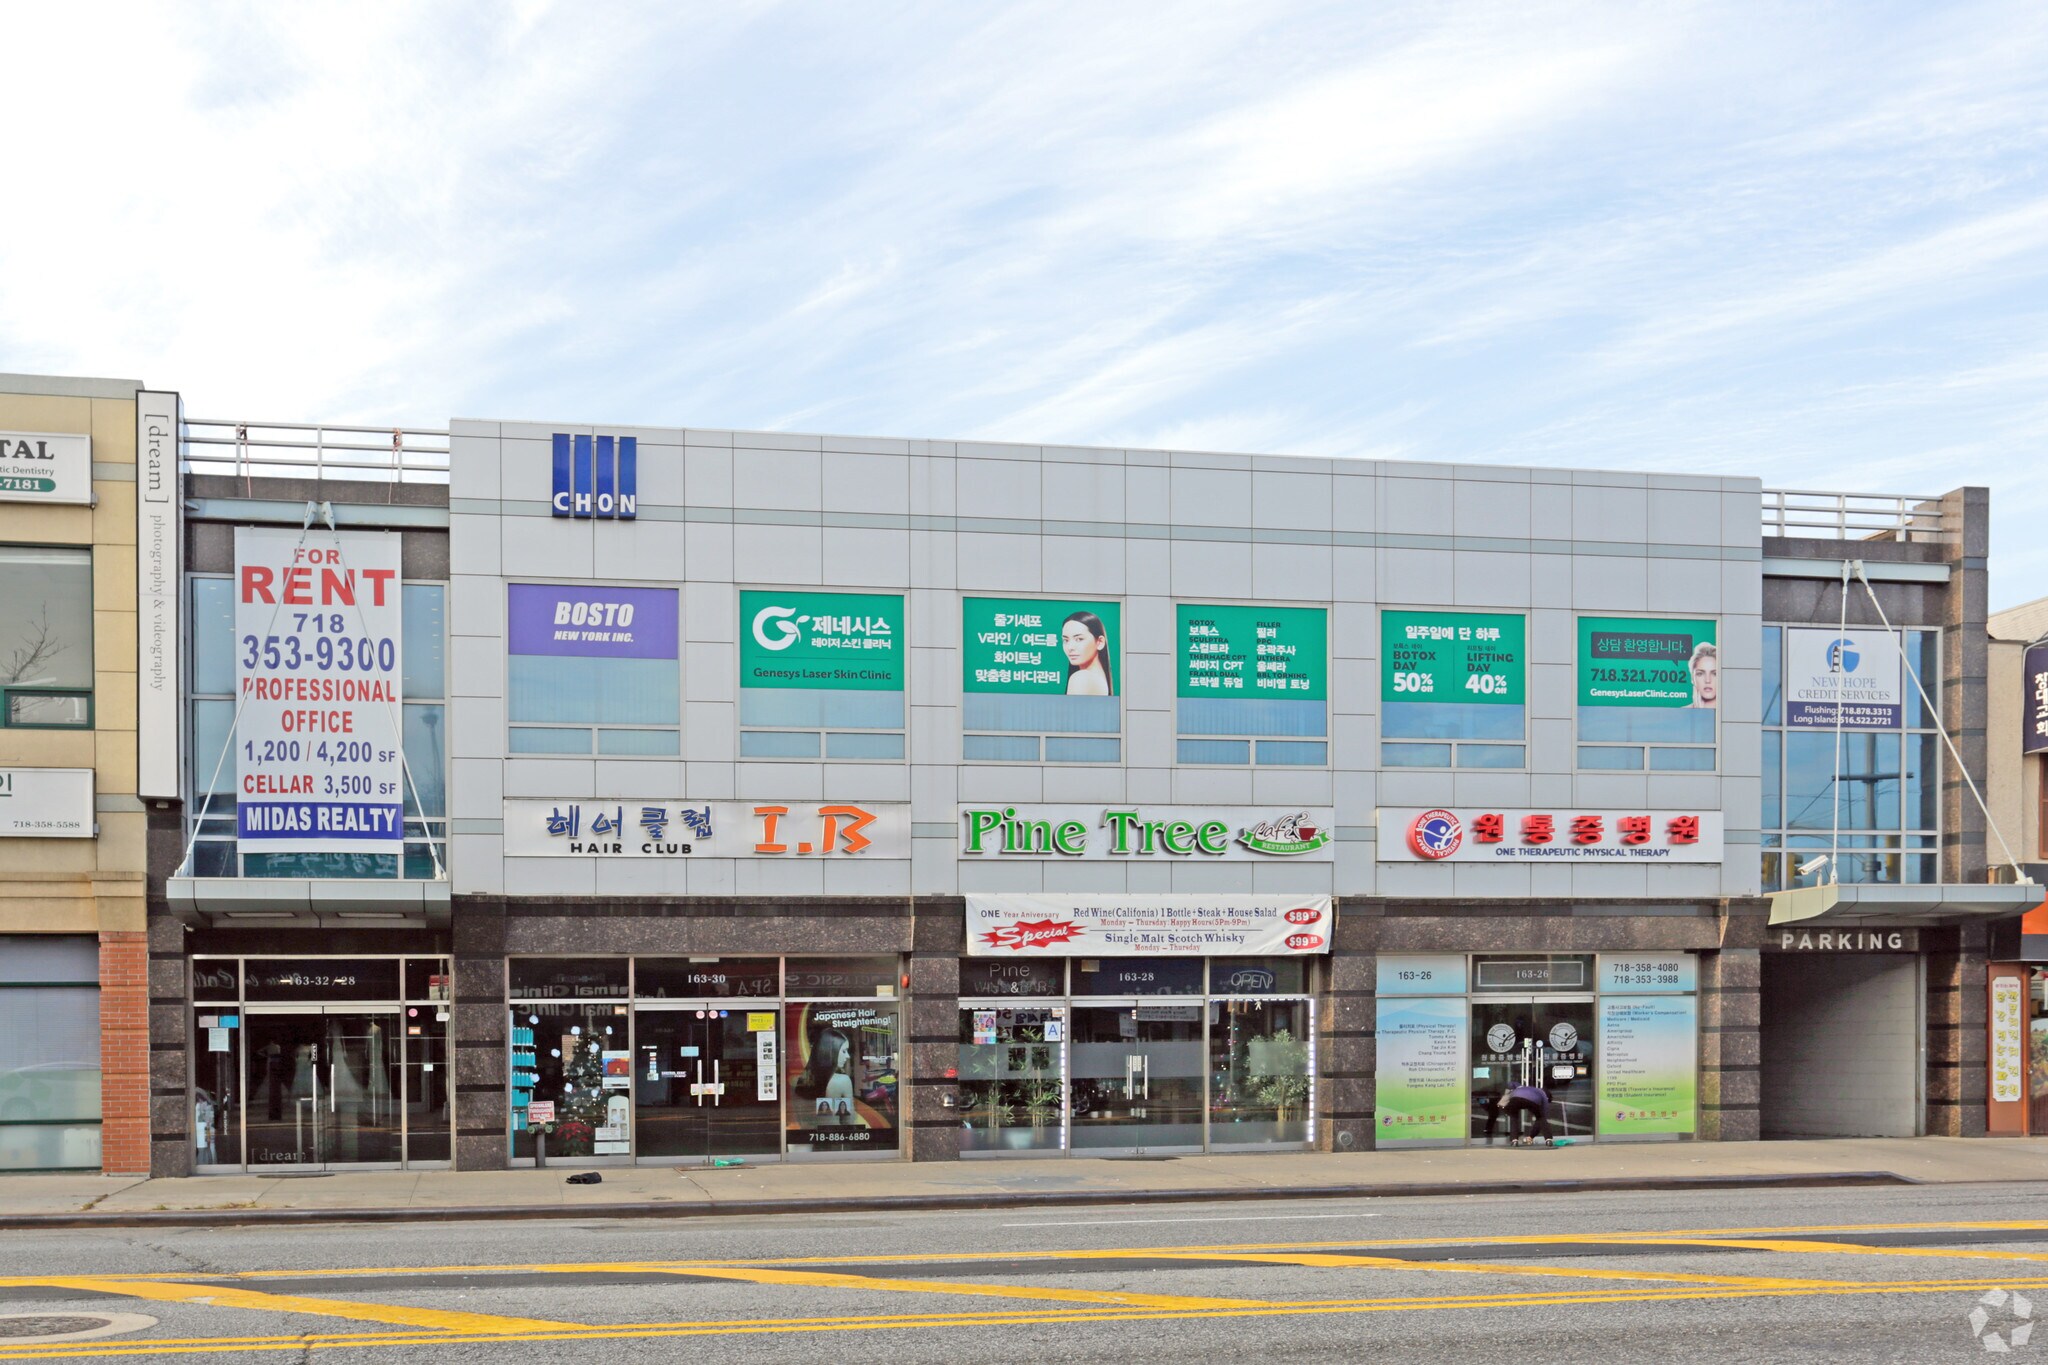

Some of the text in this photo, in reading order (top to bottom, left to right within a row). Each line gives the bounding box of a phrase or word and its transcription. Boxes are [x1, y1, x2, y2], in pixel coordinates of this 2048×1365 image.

[12, 466, 54, 477] Dentistry
[553, 492, 636, 513] CHON
[294, 549, 340, 565] FOR
[241, 566, 395, 607] RENT
[149, 514, 167, 691] photography & videography
[554, 602, 634, 627] BOSTO
[994, 614, 1042, 627] 줄기세포
[293, 613, 345, 633] 718
[811, 615, 892, 636] 제네시스
[554, 631, 634, 643] NEW YORK INC.
[1189, 626, 1219, 636] 보톡스
[1257, 628, 1276, 638] 필러
[1405, 625, 1501, 641] 일주일에 단 하루
[811, 638, 892, 649] 레이저 스킨 클리닉
[978, 633, 1011, 646] V라인
[1022, 633, 1058, 647] 여드름
[1597, 638, 1687, 654] 상담 환영합니다.
[243, 635, 395, 671] 353-9300
[1257, 645, 1296, 655] 윤곽주사
[1393, 651, 1436, 660] BOTOX
[994, 651, 1042, 665] 화이트닝
[1467, 653, 1514, 662] LIFTING
[1189, 661, 1244, 671] 써마지 CPT
[1393, 662, 1417, 670] DAY
[1467, 663, 1490, 672] DAY
[753, 668, 892, 680] Genesys Laser Skin Clinic
[975, 669, 1060, 684] 맞춤형 바디관리
[1590, 668, 1687, 683] 718.321.7002
[1189, 677, 1243, 688] 프락셀 듀얼
[1257, 678, 1310, 690] 비비엘 토닝
[1393, 672, 1433, 692] 50%
[1465, 674, 1507, 694] 40%
[1811, 677, 1877, 688] NEW HOPE
[243, 677, 396, 702] PROFESSIONAL
[1590, 688, 1688, 698] GenesysLaserClinic.com
[1797, 689, 1890, 700] CREDIT SERVICES
[281, 710, 353, 733] OFFICE
[1794, 715, 1813, 724] Long
[245, 740, 396, 766] 1,200 / 4,200 SF
[243, 774, 397, 798] CELLAR 3,500 SF
[13, 821, 80, 829] 718-358-5588
[246, 806, 396, 832] MIDAS REALTY
[546, 805, 713, 839] 헤어클럽
[965, 806, 1230, 856] Pine Tree
[1472, 813, 1700, 845] 원통증병원
[570, 843, 693, 855] HAIR CLUB
[1261, 842, 1311, 851] RESTAURANT
[1496, 848, 1671, 857] ONE THERAPEUTIC PHYSICAL THERAPY
[981, 910, 1000, 918] ONE
[1073, 907, 1089, 917] Red
[1167, 907, 1191, 917] Bottle
[1197, 907, 1221, 917] Steak
[1228, 907, 1253, 917] House
[1254, 907, 1277, 917] Salad
[1289, 910, 1309, 921] $89
[1100, 919, 1126, 928] Monday
[1171, 919, 1191, 928] Happy
[996, 926, 1069, 947] Special
[1105, 933, 1245, 945] Single Malt Scotch Whisky
[1289, 935, 1309, 947] $99
[1781, 933, 1903, 950] PARKING
[1135, 944, 1200, 952] Monday Thursday
[989, 963, 1030, 977] Pine
[1613, 963, 1679, 972] 718-358-4080
[687, 974, 726, 983] 163-30
[1119, 973, 1155, 981] 163-28
[1399, 971, 1432, 980] 163-26
[1516, 970, 1549, 978] 163-26
[1613, 975, 1679, 984] 718-353-3988
[1231, 972, 1274, 989] OPEN
[814, 1011, 857, 1021] Japanese
[858, 1008, 876, 1017] Hair
[832, 1016, 891, 1028] Straightening!
[1048, 1024, 1058, 1036] A
[809, 1133, 870, 1141] 718-886-6880
